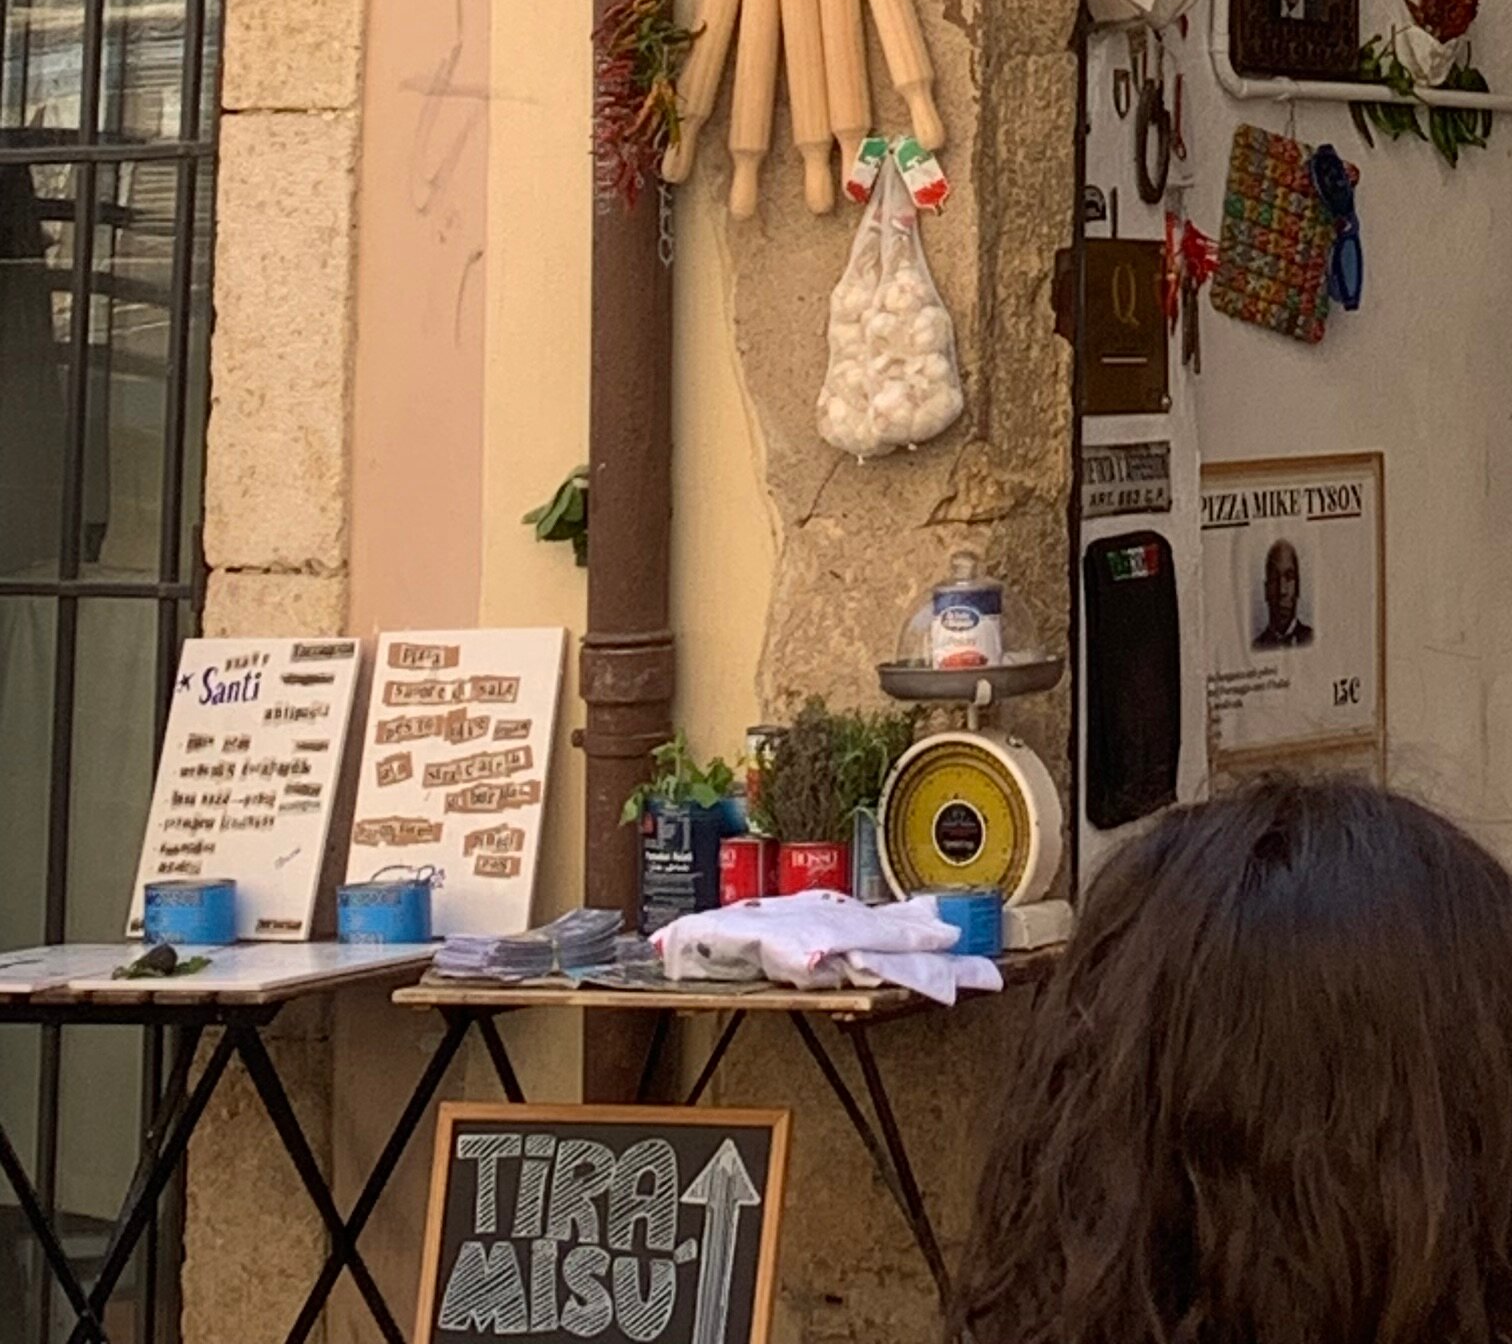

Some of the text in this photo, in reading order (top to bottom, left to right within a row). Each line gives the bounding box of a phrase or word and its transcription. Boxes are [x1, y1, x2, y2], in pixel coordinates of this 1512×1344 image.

[1252, 487, 1302, 519] MIKE
[1305, 482, 1363, 515] TYSON
[199, 665, 263, 706] Santi
